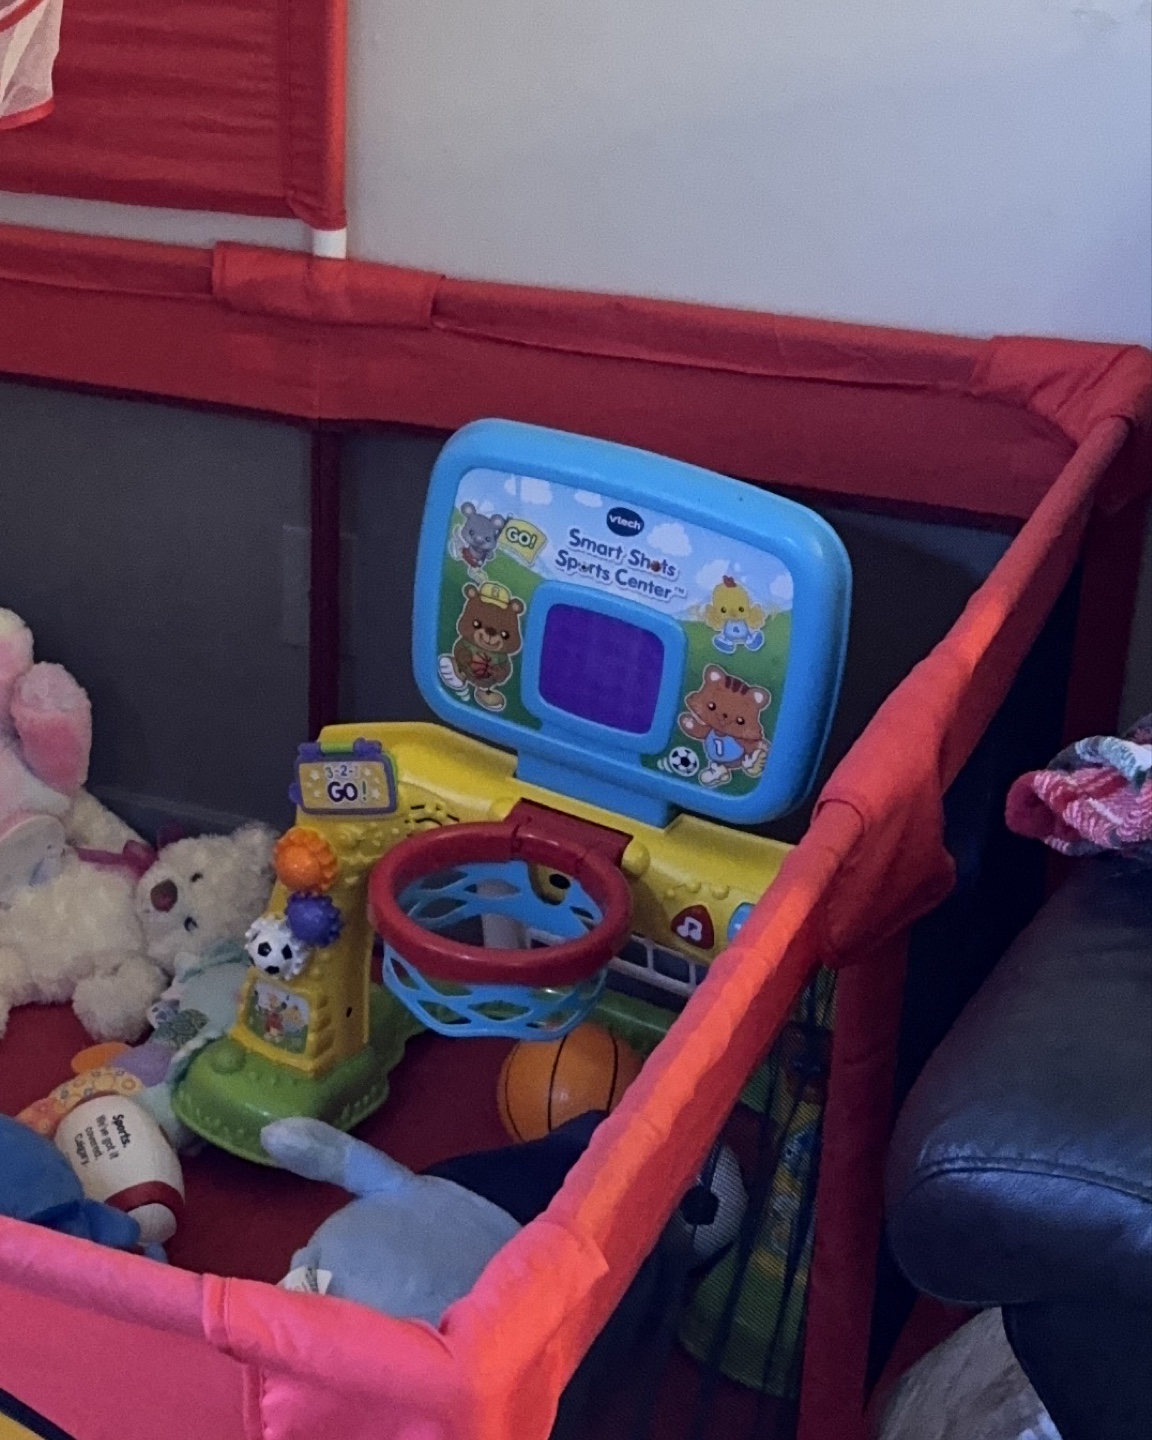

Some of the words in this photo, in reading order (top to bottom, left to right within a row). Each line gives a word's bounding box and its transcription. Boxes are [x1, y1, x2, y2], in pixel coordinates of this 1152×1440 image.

[505, 526, 538, 550] GO!
[554, 549, 611, 582] Sports
[568, 527, 623, 561] Smart
[627, 548, 677, 578] Shots
[713, 738, 725, 757] 1
